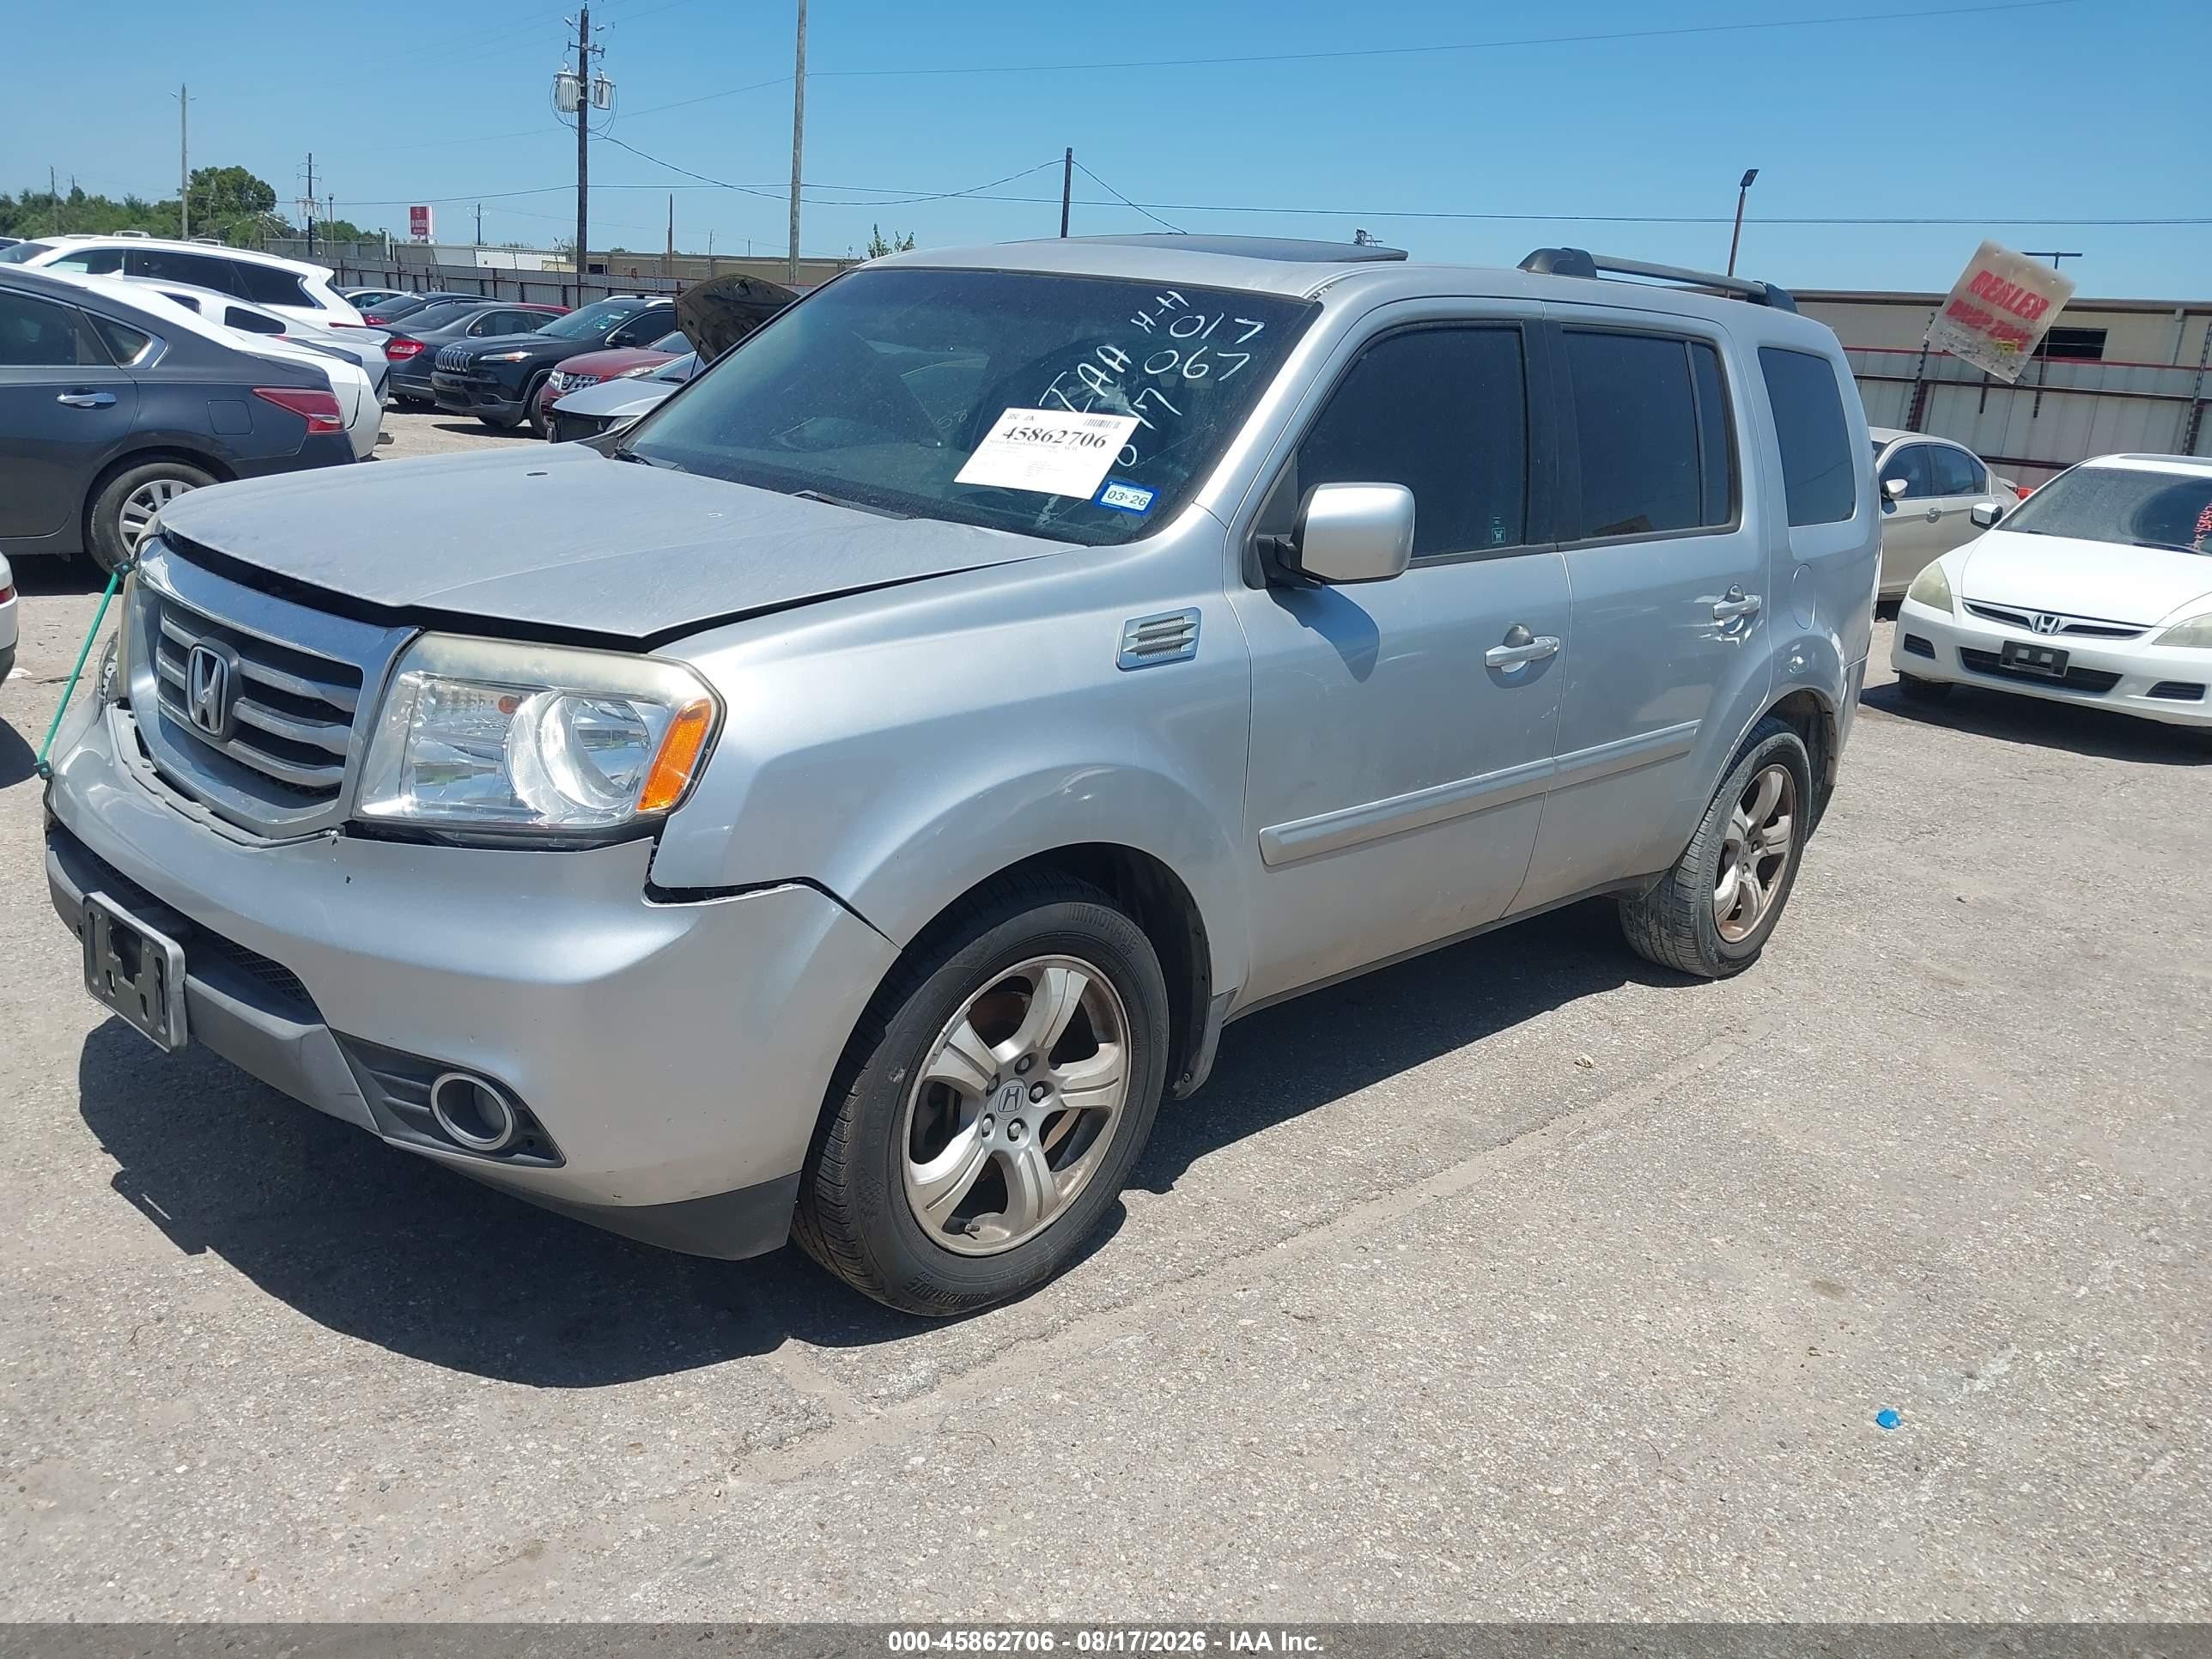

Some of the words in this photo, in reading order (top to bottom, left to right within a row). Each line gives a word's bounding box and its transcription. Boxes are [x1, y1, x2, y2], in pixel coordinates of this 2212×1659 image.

[1967, 270, 2050, 323] DEALER
[1170, 312, 1266, 344] 017
[1144, 345, 1250, 381] 067
[1002, 426, 1110, 449] 45862706
[1107, 490, 1126, 501] 03
[1129, 495, 1148, 506] 26
